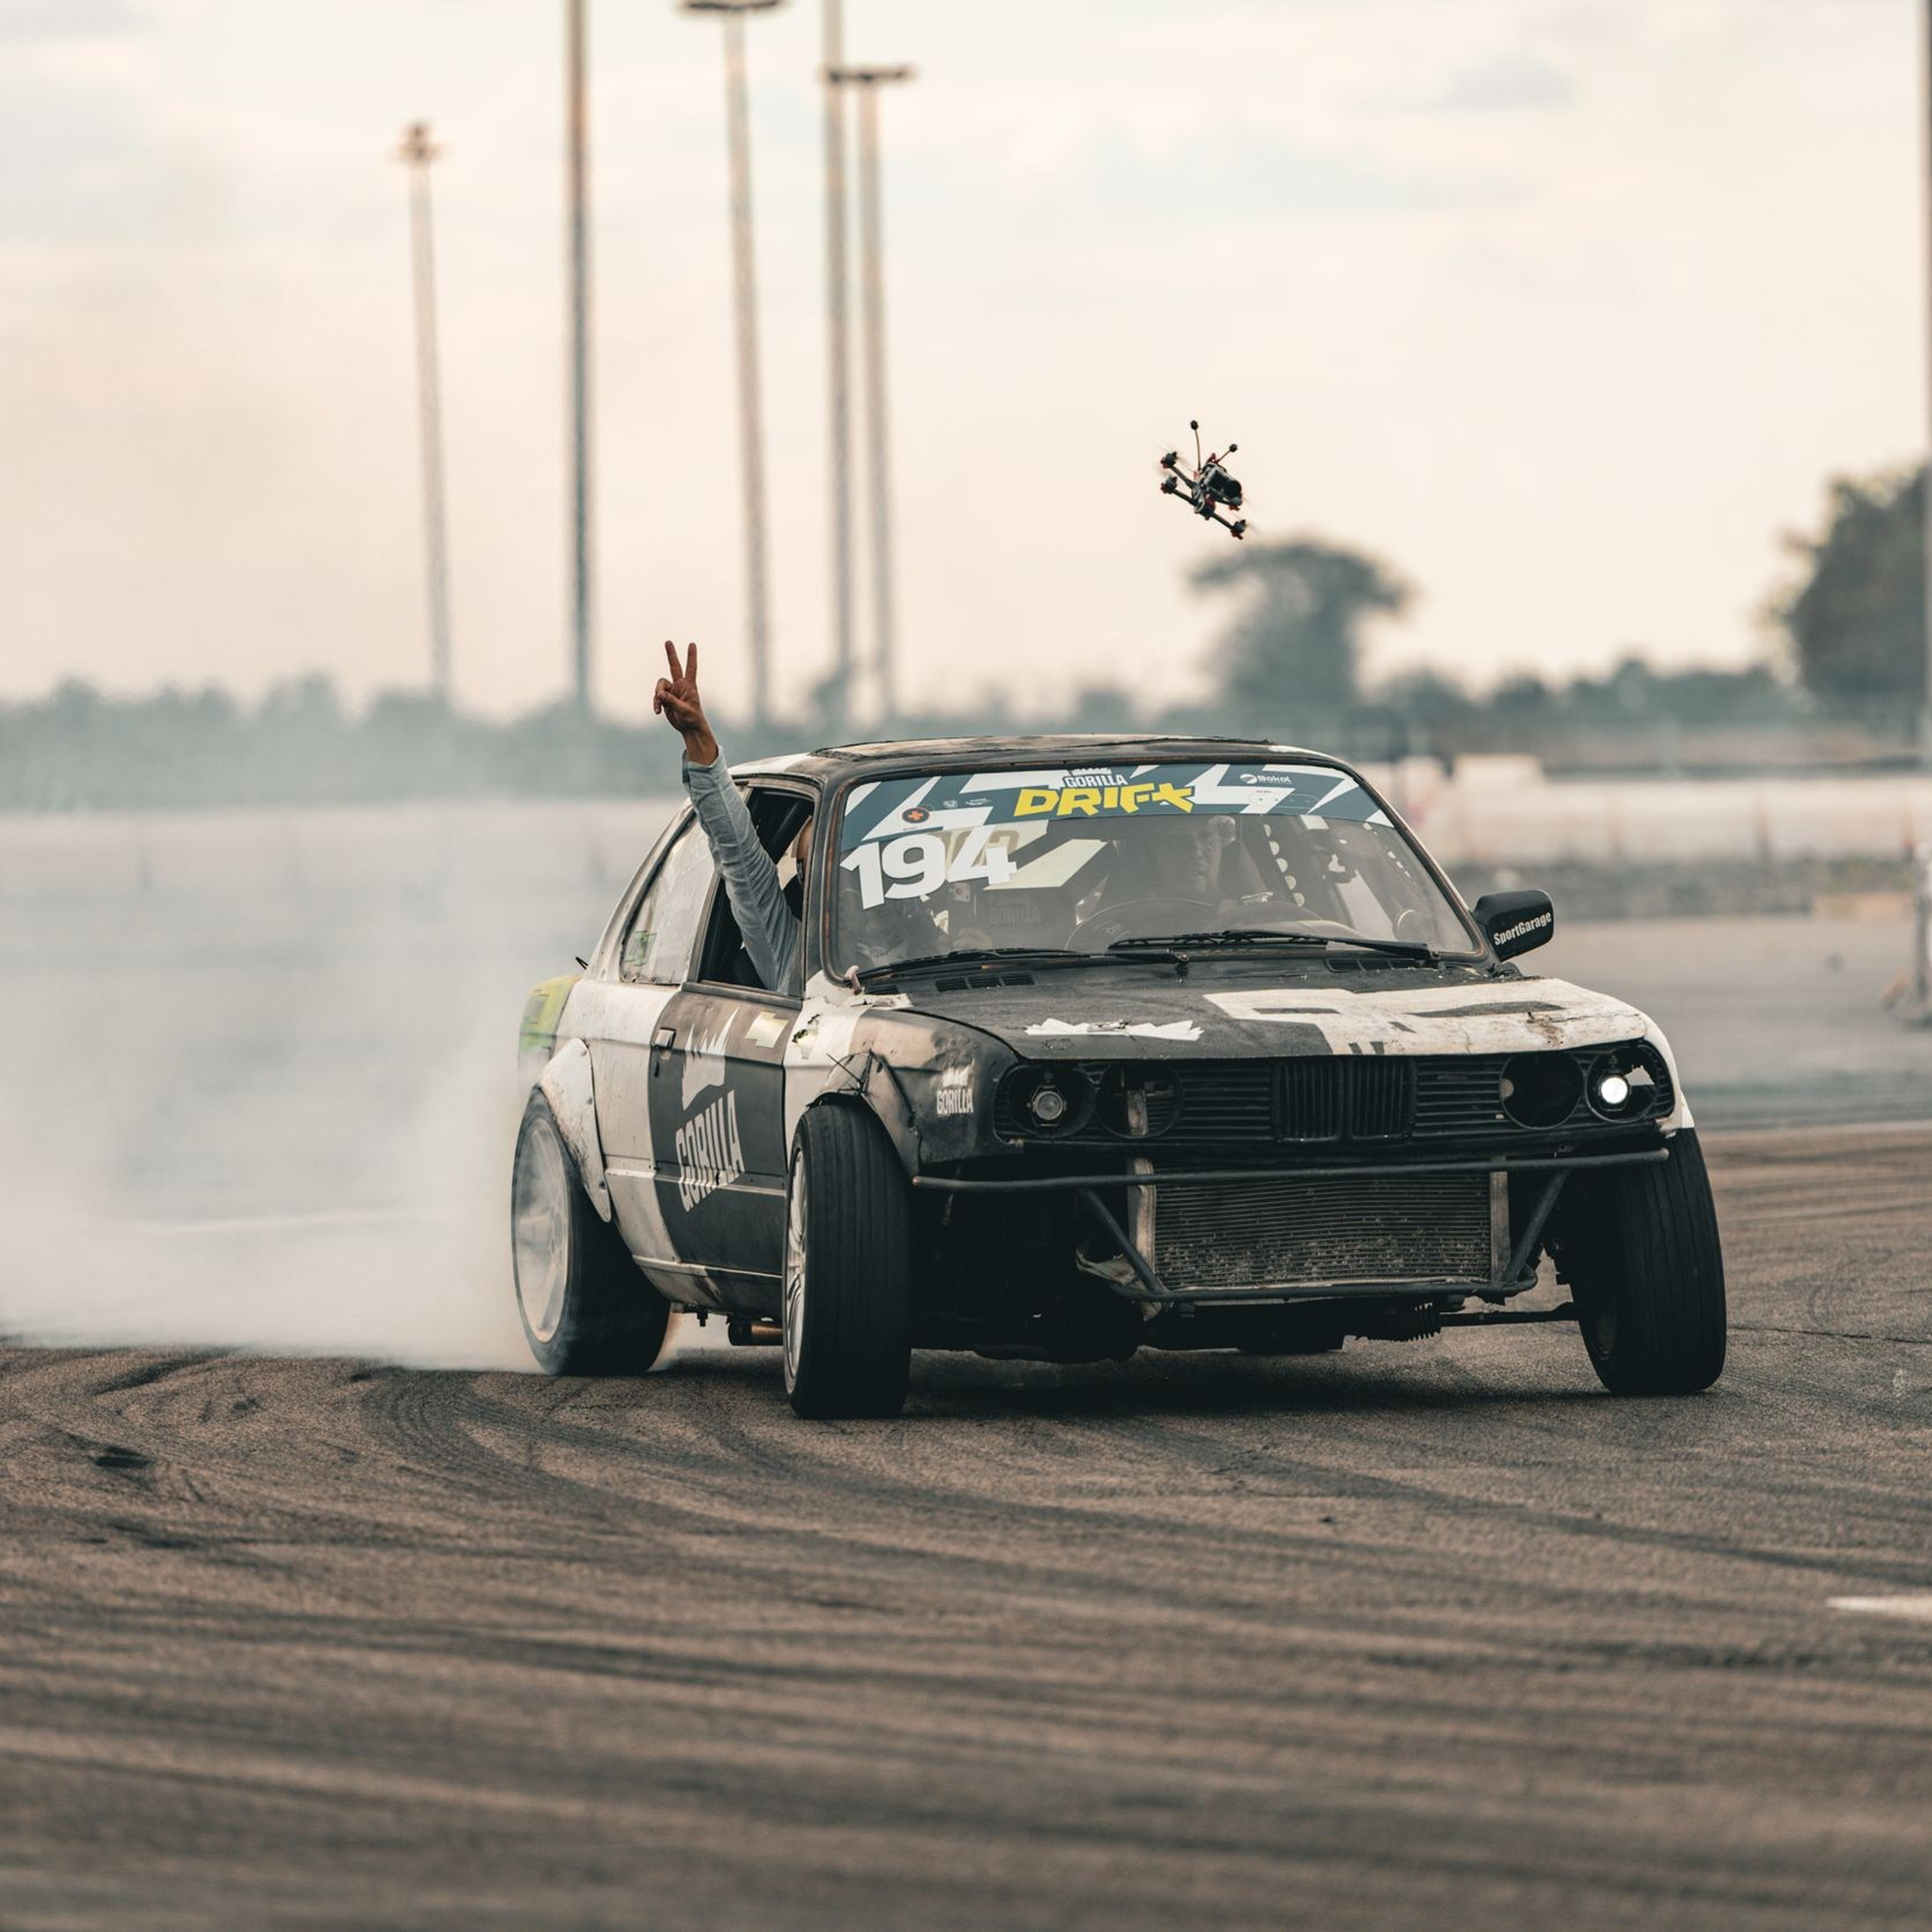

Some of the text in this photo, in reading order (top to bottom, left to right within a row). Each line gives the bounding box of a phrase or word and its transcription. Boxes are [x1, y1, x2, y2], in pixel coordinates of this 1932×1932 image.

[1065, 774, 1128, 788] GORILLA
[1014, 783, 1194, 817] DRIFT
[839, 825, 1018, 910] 194
[1494, 912, 1552, 946] SportGarage
[937, 1088, 974, 1115] GORILLA
[675, 1090, 745, 1213] GORILLA
